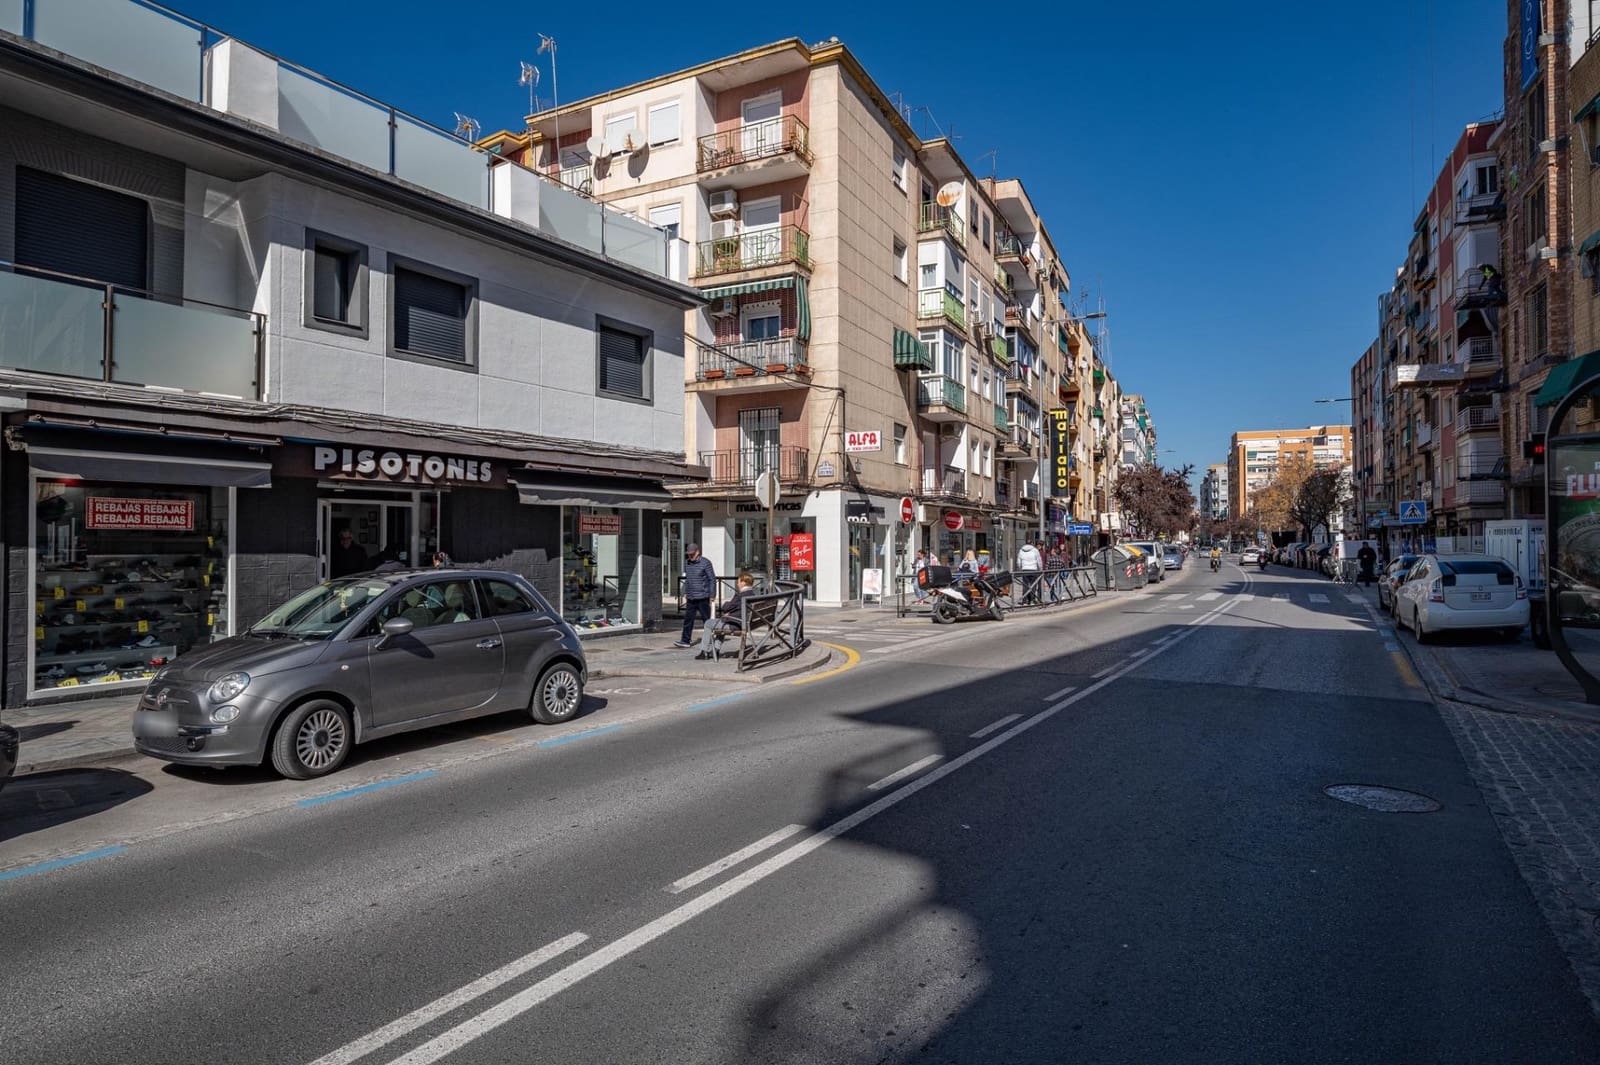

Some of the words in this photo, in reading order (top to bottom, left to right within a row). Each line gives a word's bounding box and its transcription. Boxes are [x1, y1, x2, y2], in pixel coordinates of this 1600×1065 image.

[848, 432, 877, 446] ALFA
[314, 446, 492, 482] PISOTONES
[95, 503, 141, 513] REBAJAS
[143, 504, 186, 514] REBAJAS
[95, 514, 141, 524] REBAJAS
[143, 514, 186, 525] REBAJAS
